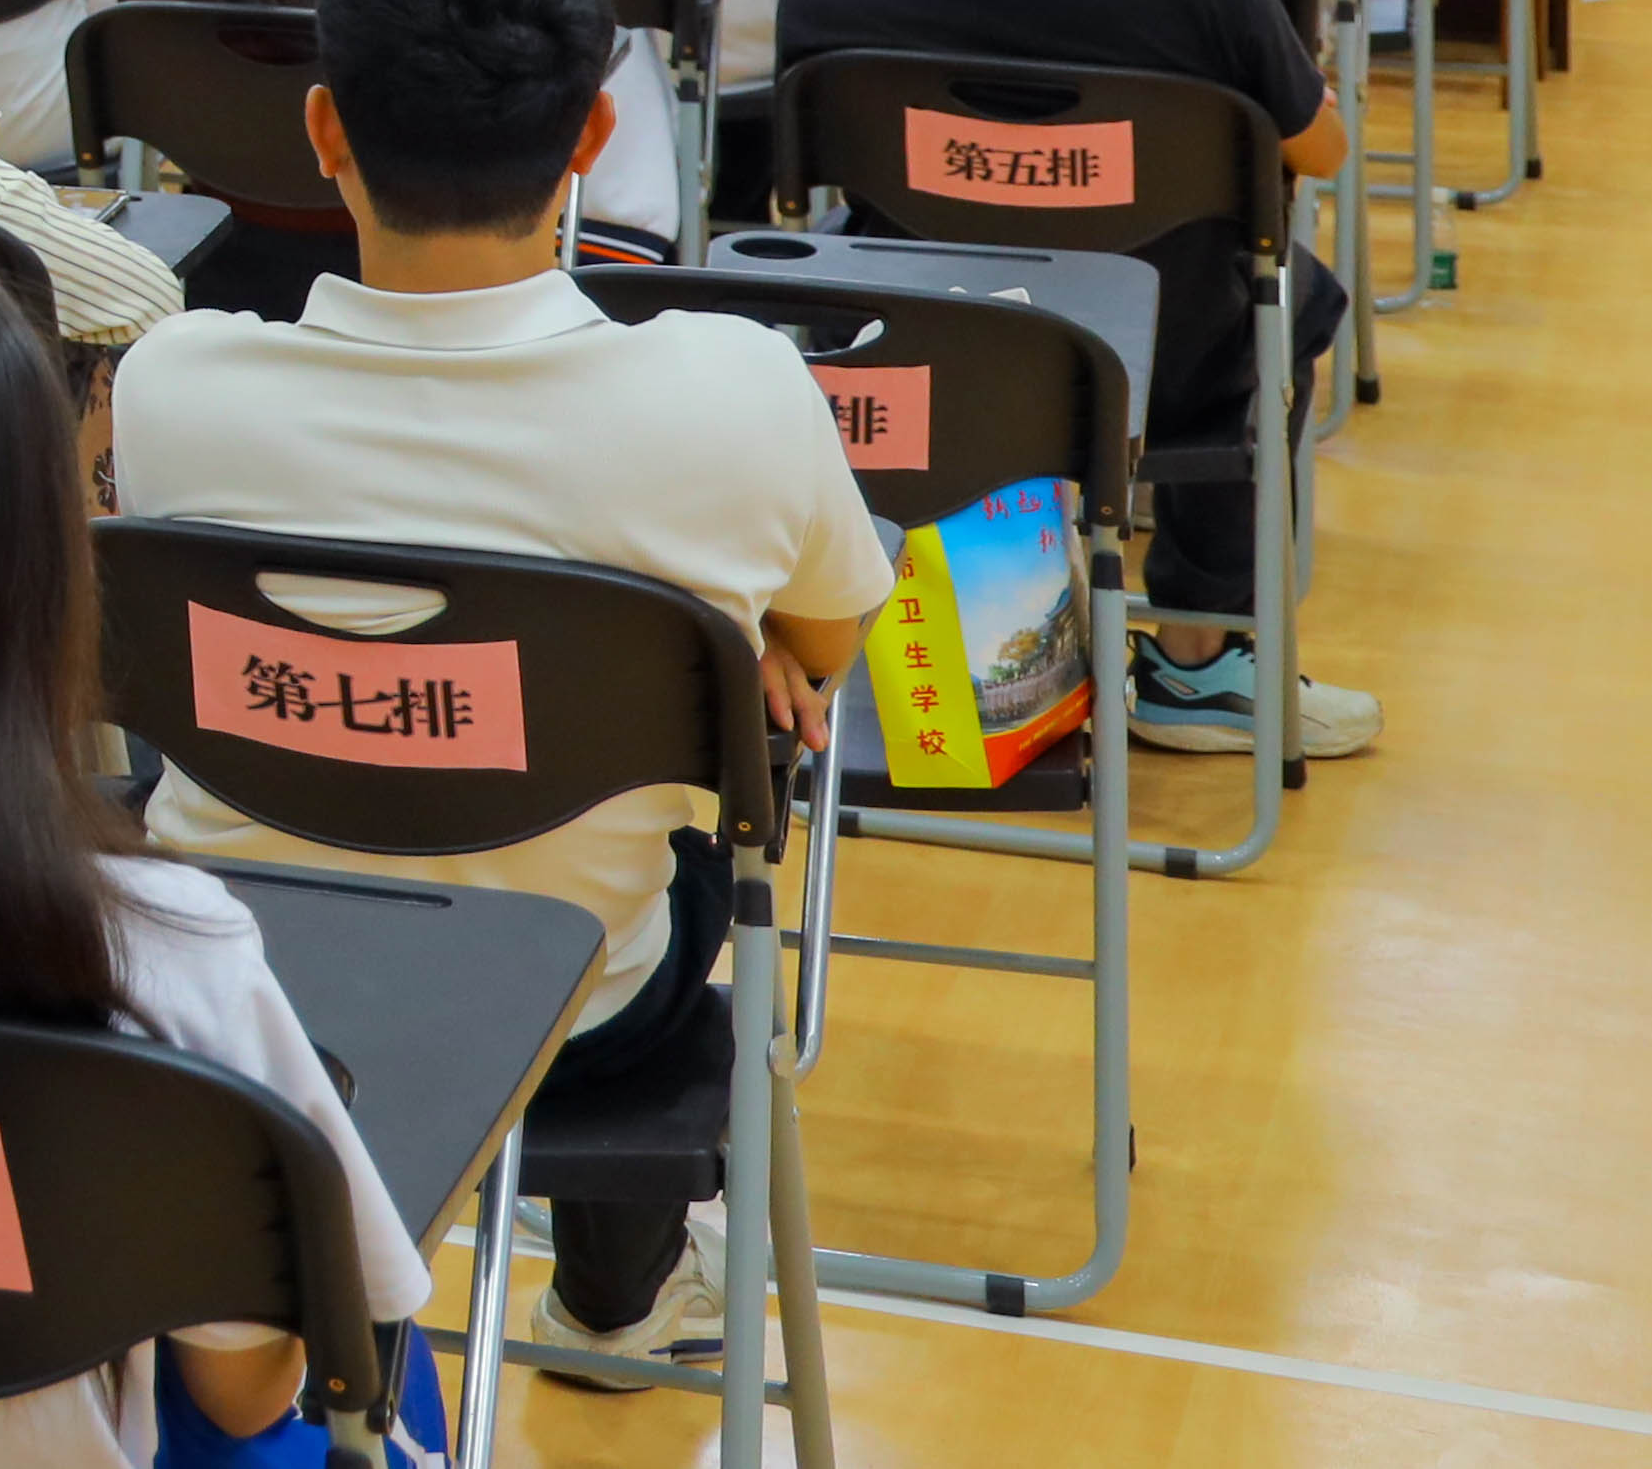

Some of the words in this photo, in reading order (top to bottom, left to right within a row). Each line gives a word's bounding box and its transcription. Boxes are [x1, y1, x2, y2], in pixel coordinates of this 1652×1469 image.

[944, 139, 1100, 188] 第五排
[242, 654, 474, 740] 第七排
